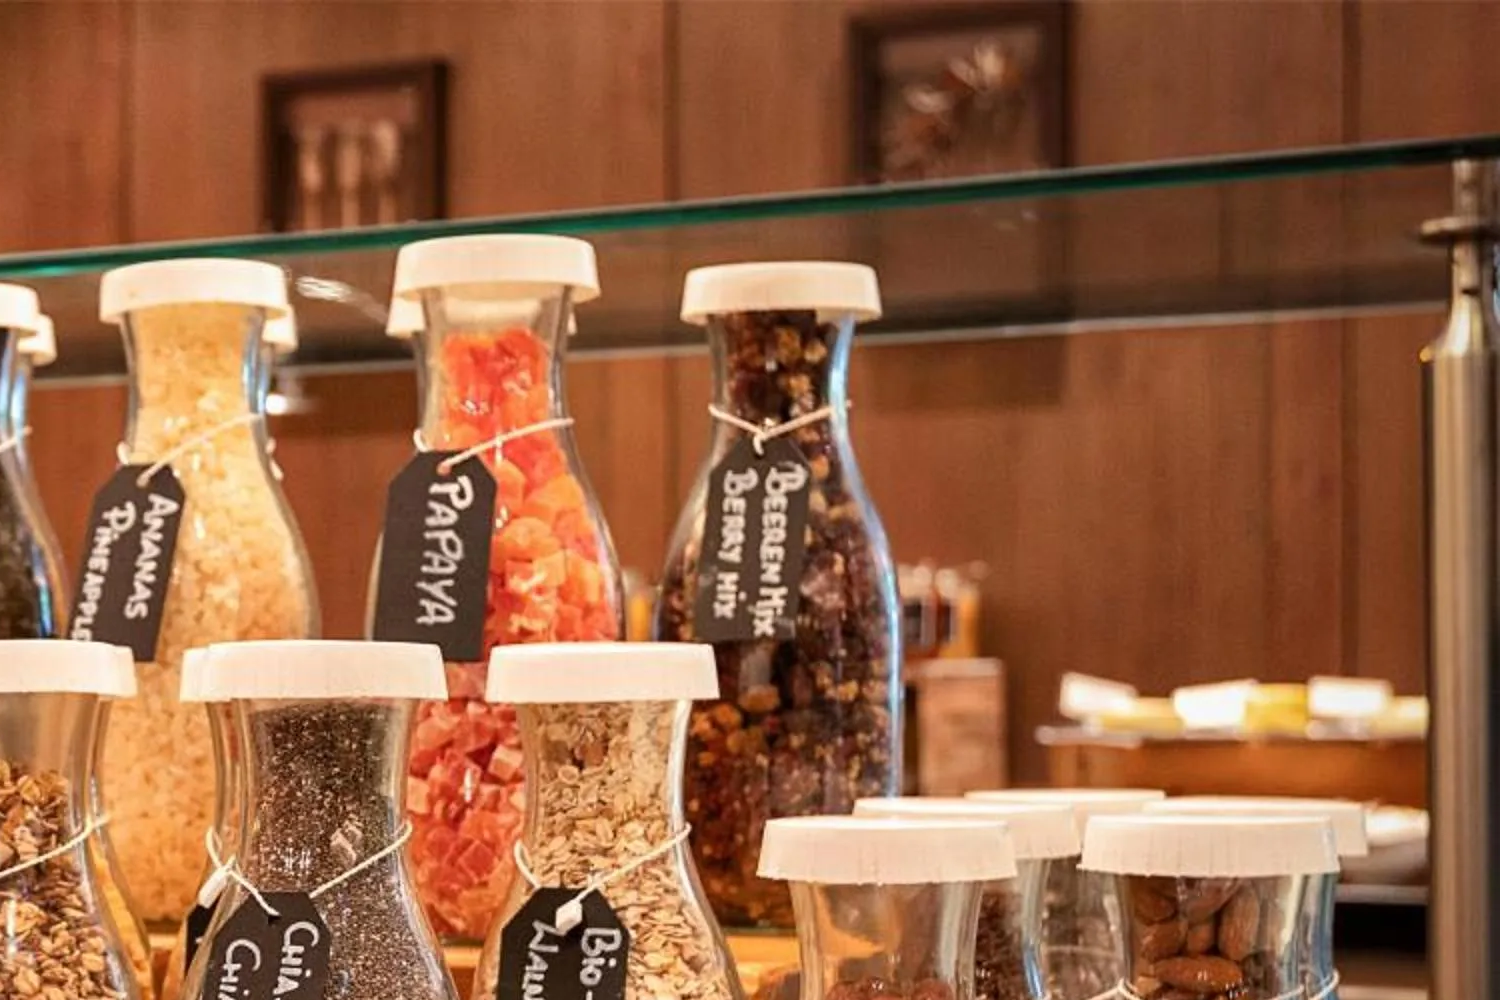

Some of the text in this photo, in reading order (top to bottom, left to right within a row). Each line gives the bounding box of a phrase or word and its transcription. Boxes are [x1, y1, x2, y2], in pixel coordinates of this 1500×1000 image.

[123, 493, 180, 620] ANANAS
[414, 474, 476, 627] PAPAYA
[717, 467, 759, 563] BERRY
